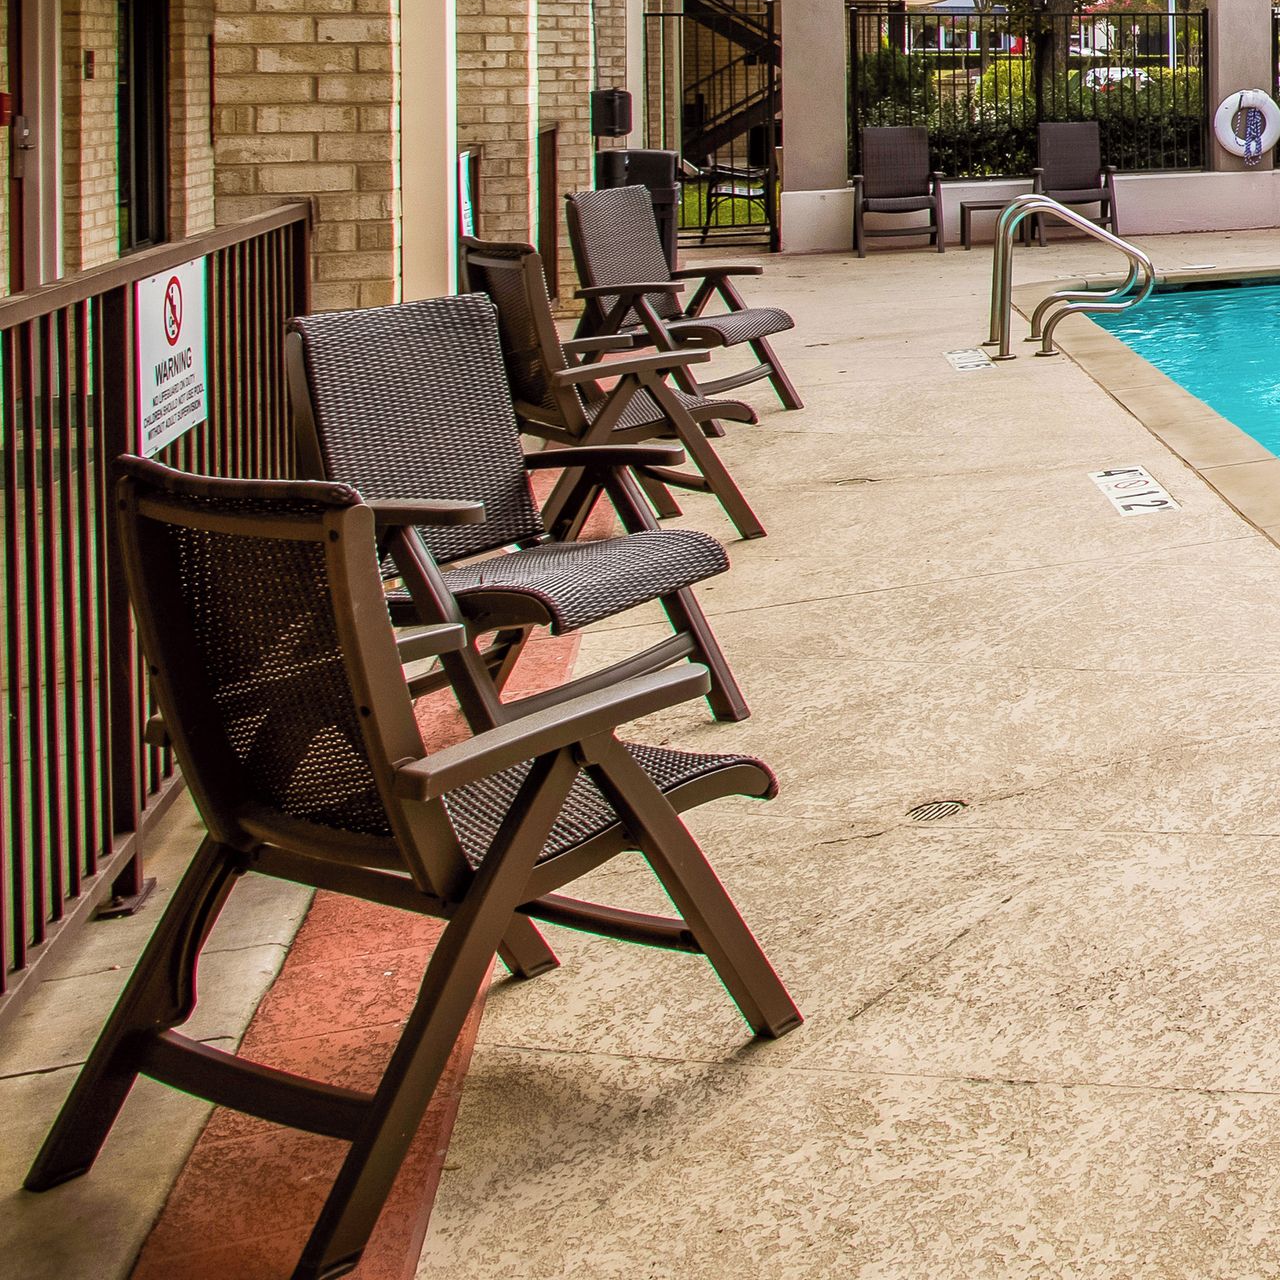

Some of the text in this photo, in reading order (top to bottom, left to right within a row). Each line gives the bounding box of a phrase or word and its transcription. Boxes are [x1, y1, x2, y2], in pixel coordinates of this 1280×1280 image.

[154, 346, 192, 386] WARNING
[143, 408, 163, 428] CHILDREN
[163, 398, 177, 416] SHOULD
[178, 392, 186, 405] NOT
[194, 383, 204, 397] POOL
[159, 382, 179, 404] LIFEGUARD
[185, 374, 195, 387] DUTY
[148, 399, 201, 440] WITHOUT ADULT SUPERVISION
[1097, 469, 1139, 478] 4
